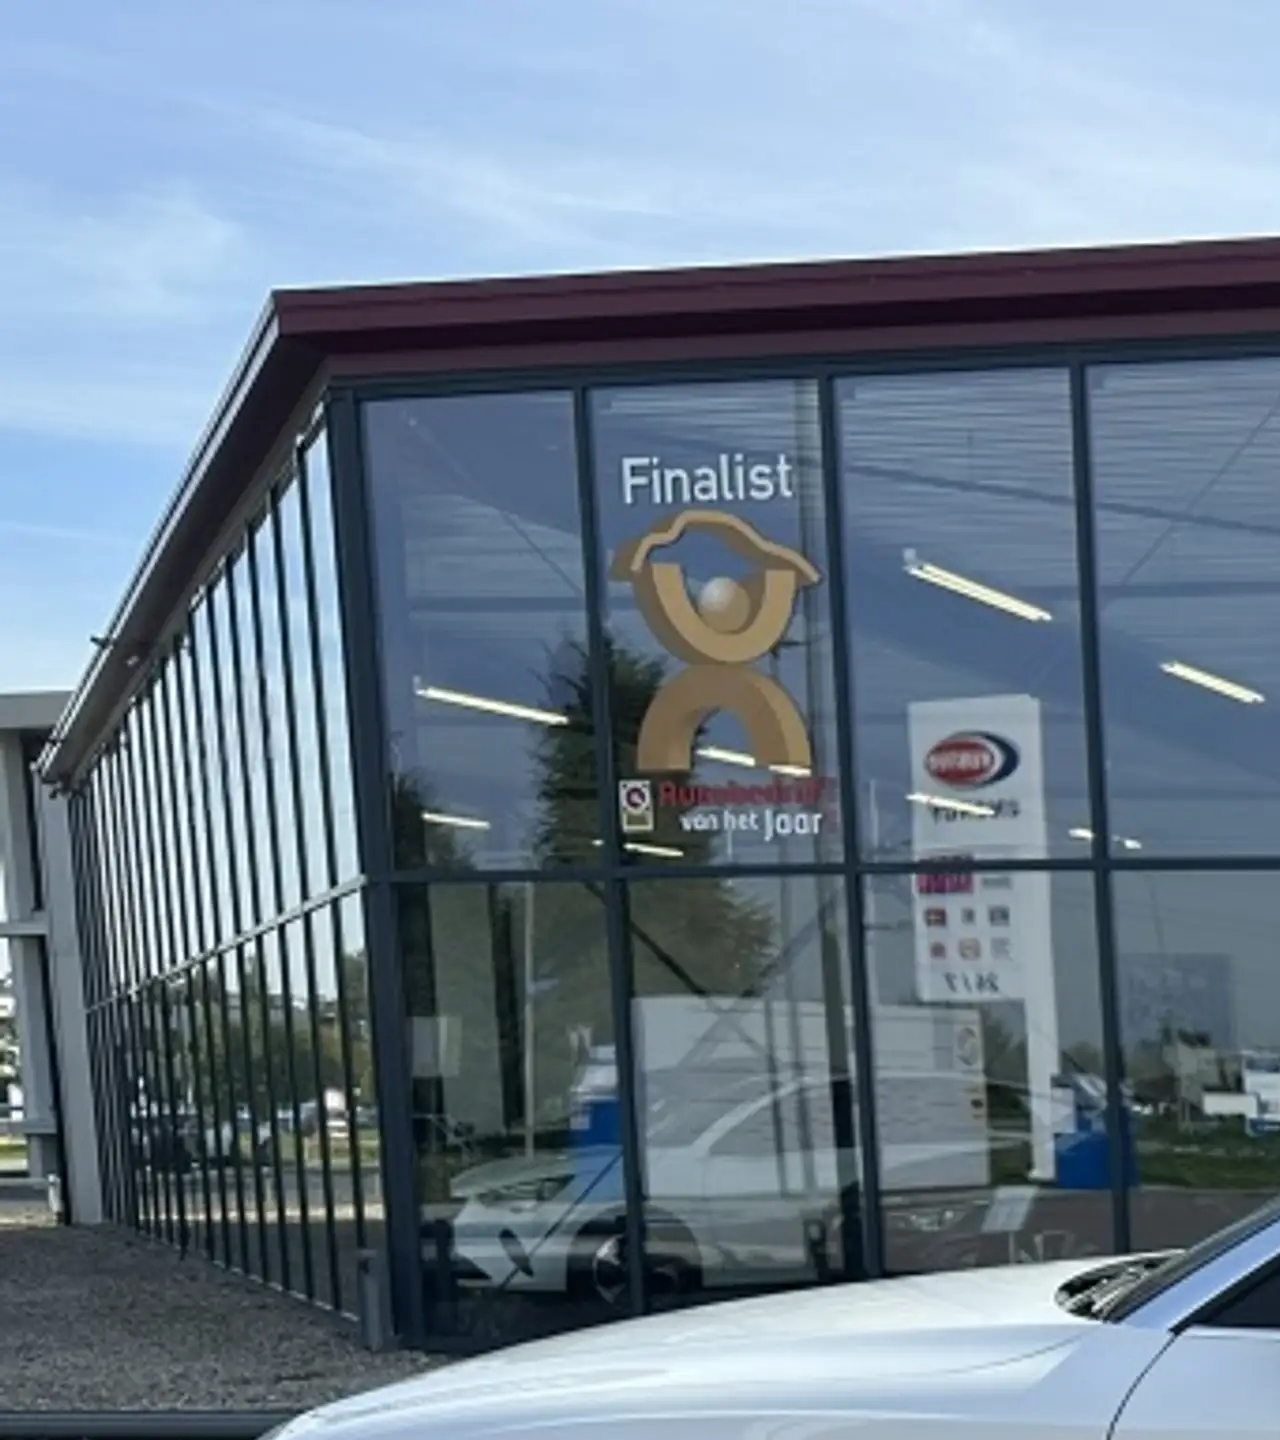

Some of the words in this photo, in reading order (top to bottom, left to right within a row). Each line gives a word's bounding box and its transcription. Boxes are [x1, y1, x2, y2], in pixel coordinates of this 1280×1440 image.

[622, 453, 793, 504] Finalist
[680, 812, 719, 832] van
[723, 809, 759, 831] het
